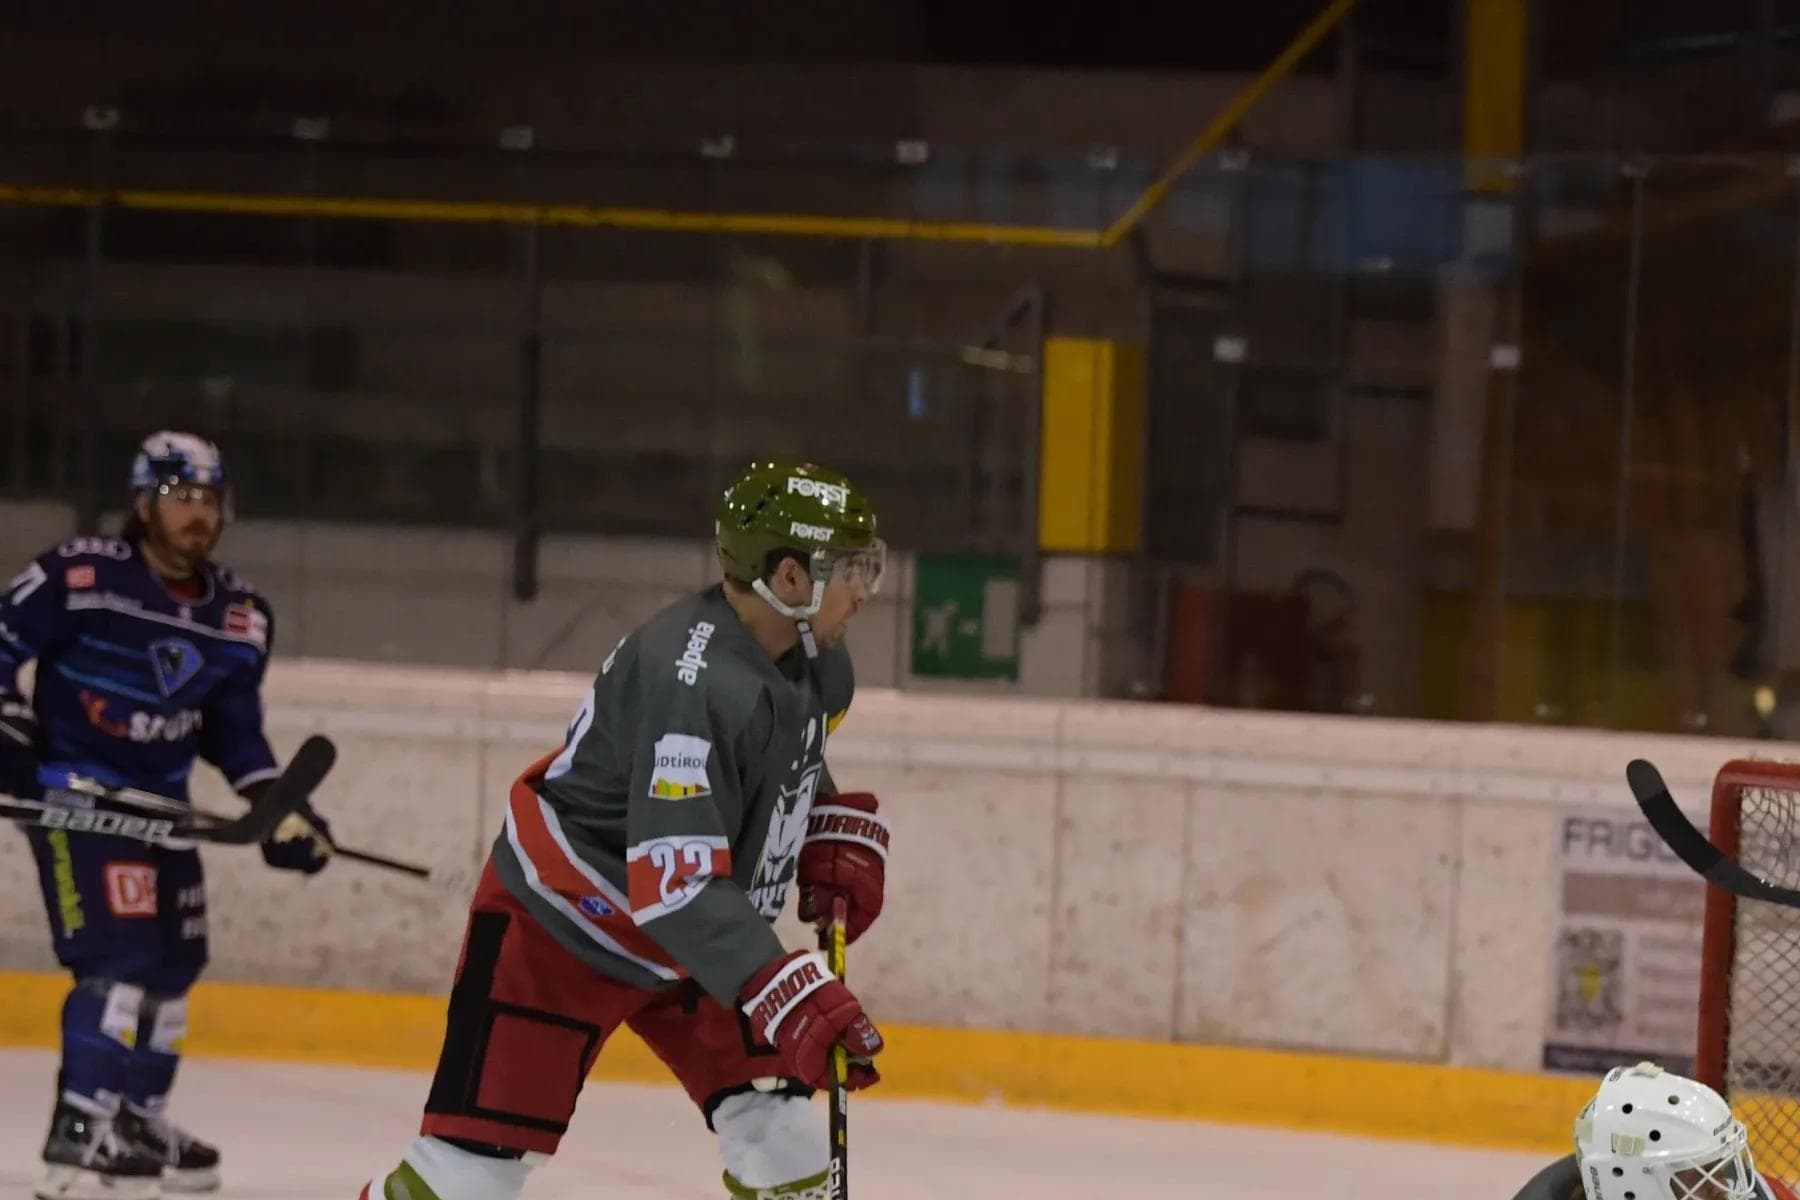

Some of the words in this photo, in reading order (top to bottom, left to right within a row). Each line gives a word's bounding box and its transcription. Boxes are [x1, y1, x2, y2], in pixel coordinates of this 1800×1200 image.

[787, 476, 851, 509] FORST
[790, 521, 834, 542] FORST
[675, 621, 715, 686] alperia
